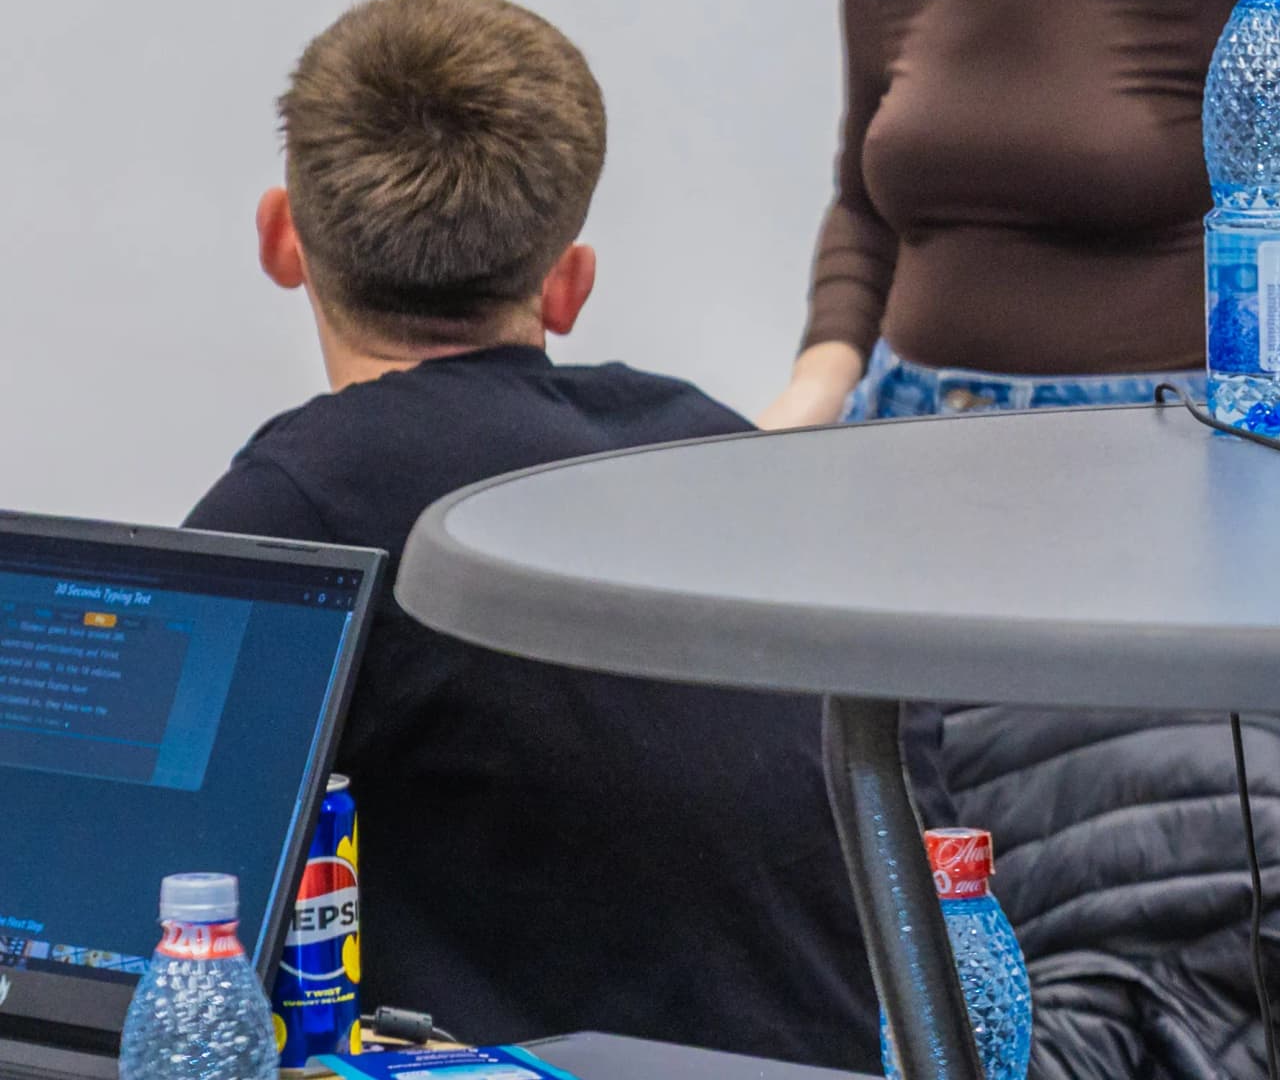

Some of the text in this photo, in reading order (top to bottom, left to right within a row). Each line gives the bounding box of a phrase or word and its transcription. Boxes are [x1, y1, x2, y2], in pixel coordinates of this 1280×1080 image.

[67, 583, 102, 600] Seconds
[103, 587, 133, 607] Typing
[133, 591, 152, 605] Test
[292, 899, 359, 931] EPSI
